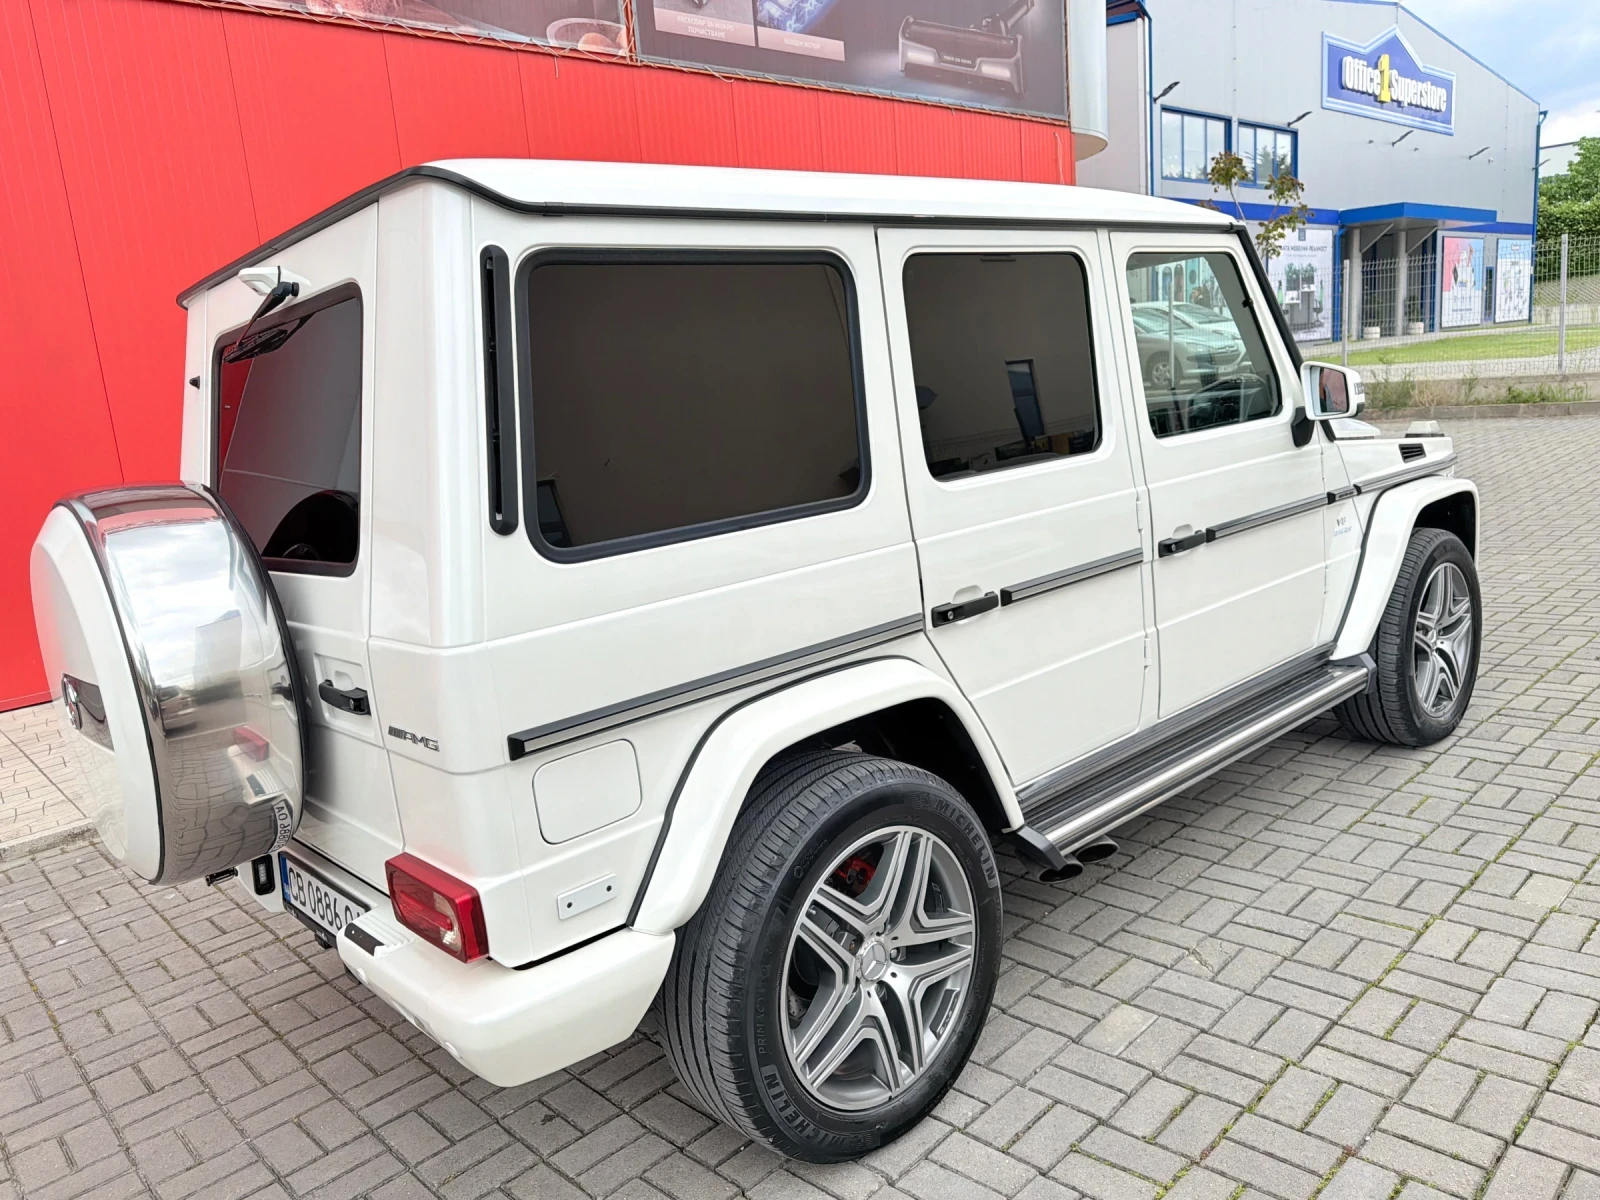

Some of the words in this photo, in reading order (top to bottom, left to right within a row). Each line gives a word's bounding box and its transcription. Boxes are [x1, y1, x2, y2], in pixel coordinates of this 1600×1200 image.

[1342, 55, 1381, 96] Office
[1378, 53, 1391, 103] 1
[1390, 69, 1447, 113] Superstore
[933, 797, 996, 881] MICHELIN
[288, 867, 307, 908] CB
[307, 880, 343, 930] 0886
[763, 1072, 847, 1146] MICHELIN
